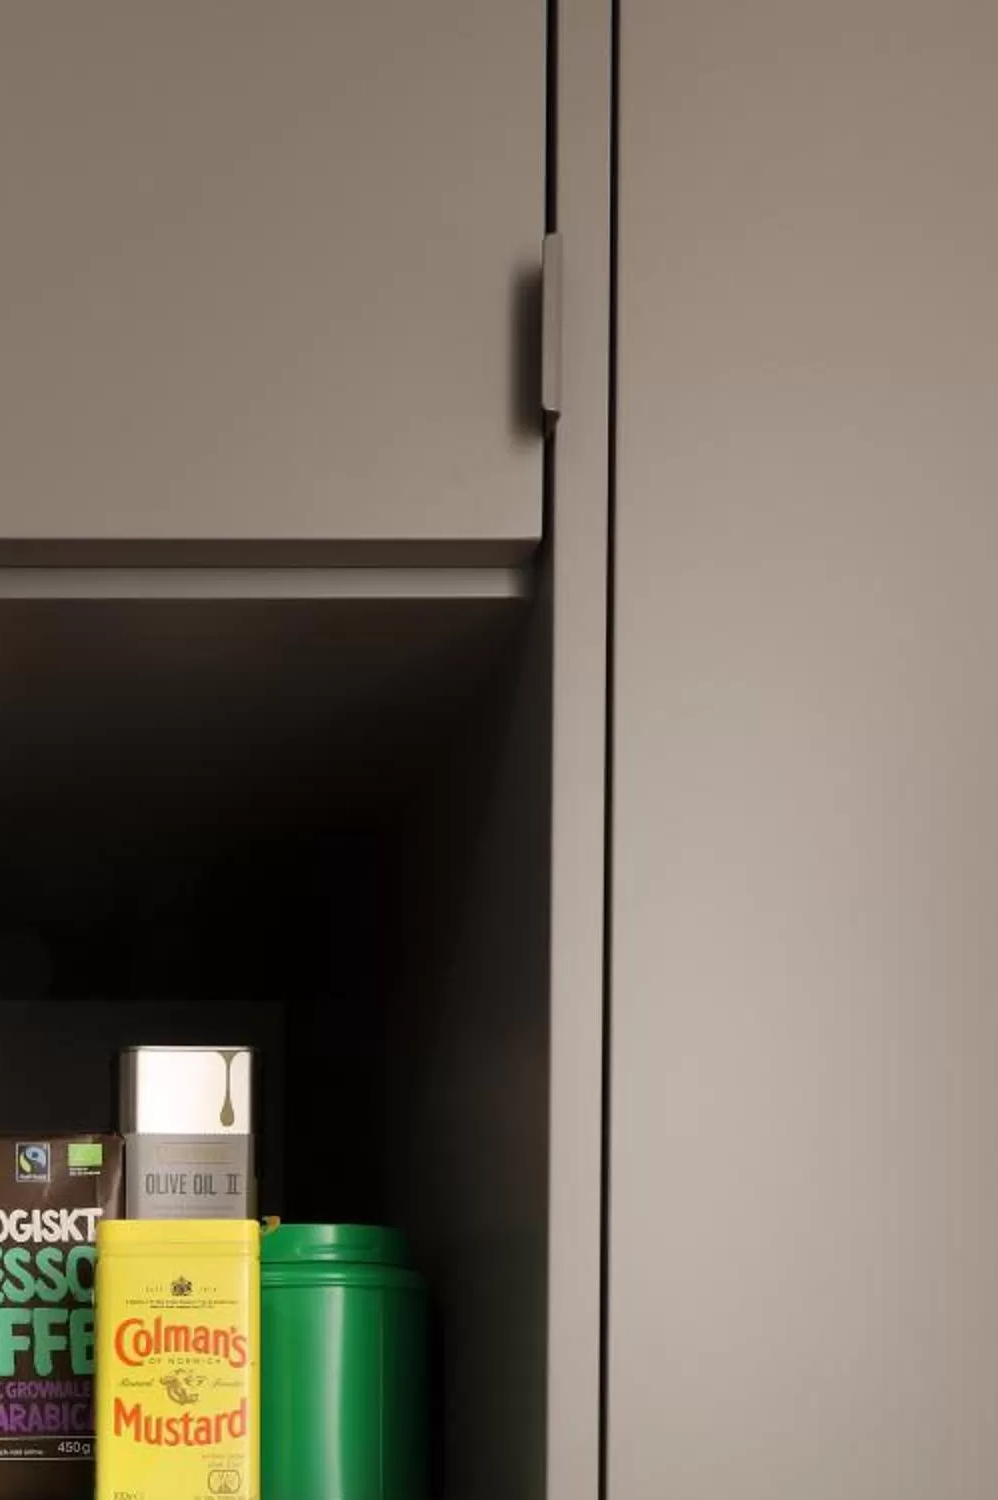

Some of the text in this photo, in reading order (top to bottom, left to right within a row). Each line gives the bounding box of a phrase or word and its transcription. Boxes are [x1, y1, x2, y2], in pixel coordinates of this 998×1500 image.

[145, 1173, 188, 1195] OLIVE
[193, 1173, 218, 1195] OIL
[114, 1315, 247, 1369] Colman's
[114, 1397, 247, 1447] Mustard
